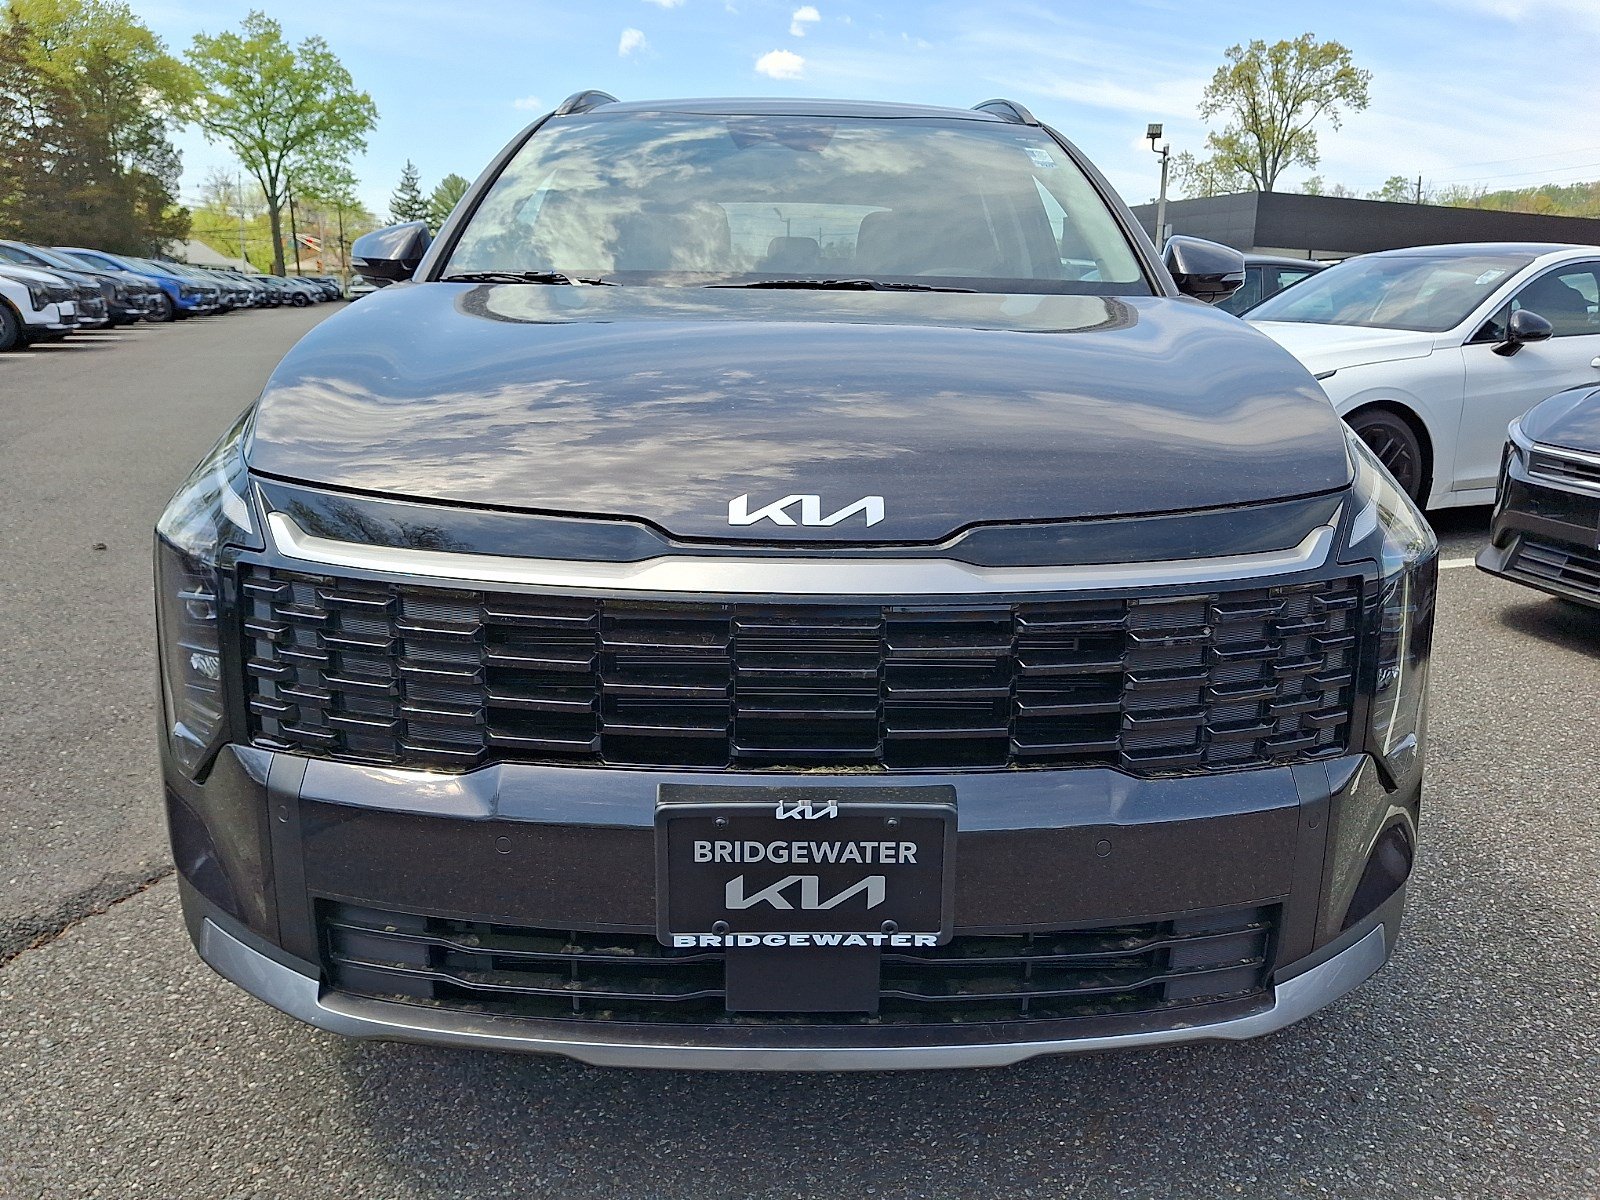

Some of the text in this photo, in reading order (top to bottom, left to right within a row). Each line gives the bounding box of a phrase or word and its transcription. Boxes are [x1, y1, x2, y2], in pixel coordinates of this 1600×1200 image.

[728, 494, 885, 527] KIA
[776, 801, 838, 820] KIA
[694, 841, 917, 864] BRIDGEWATER
[726, 875, 886, 909] KIA
[674, 934, 937, 947] BRIDGEWATER
